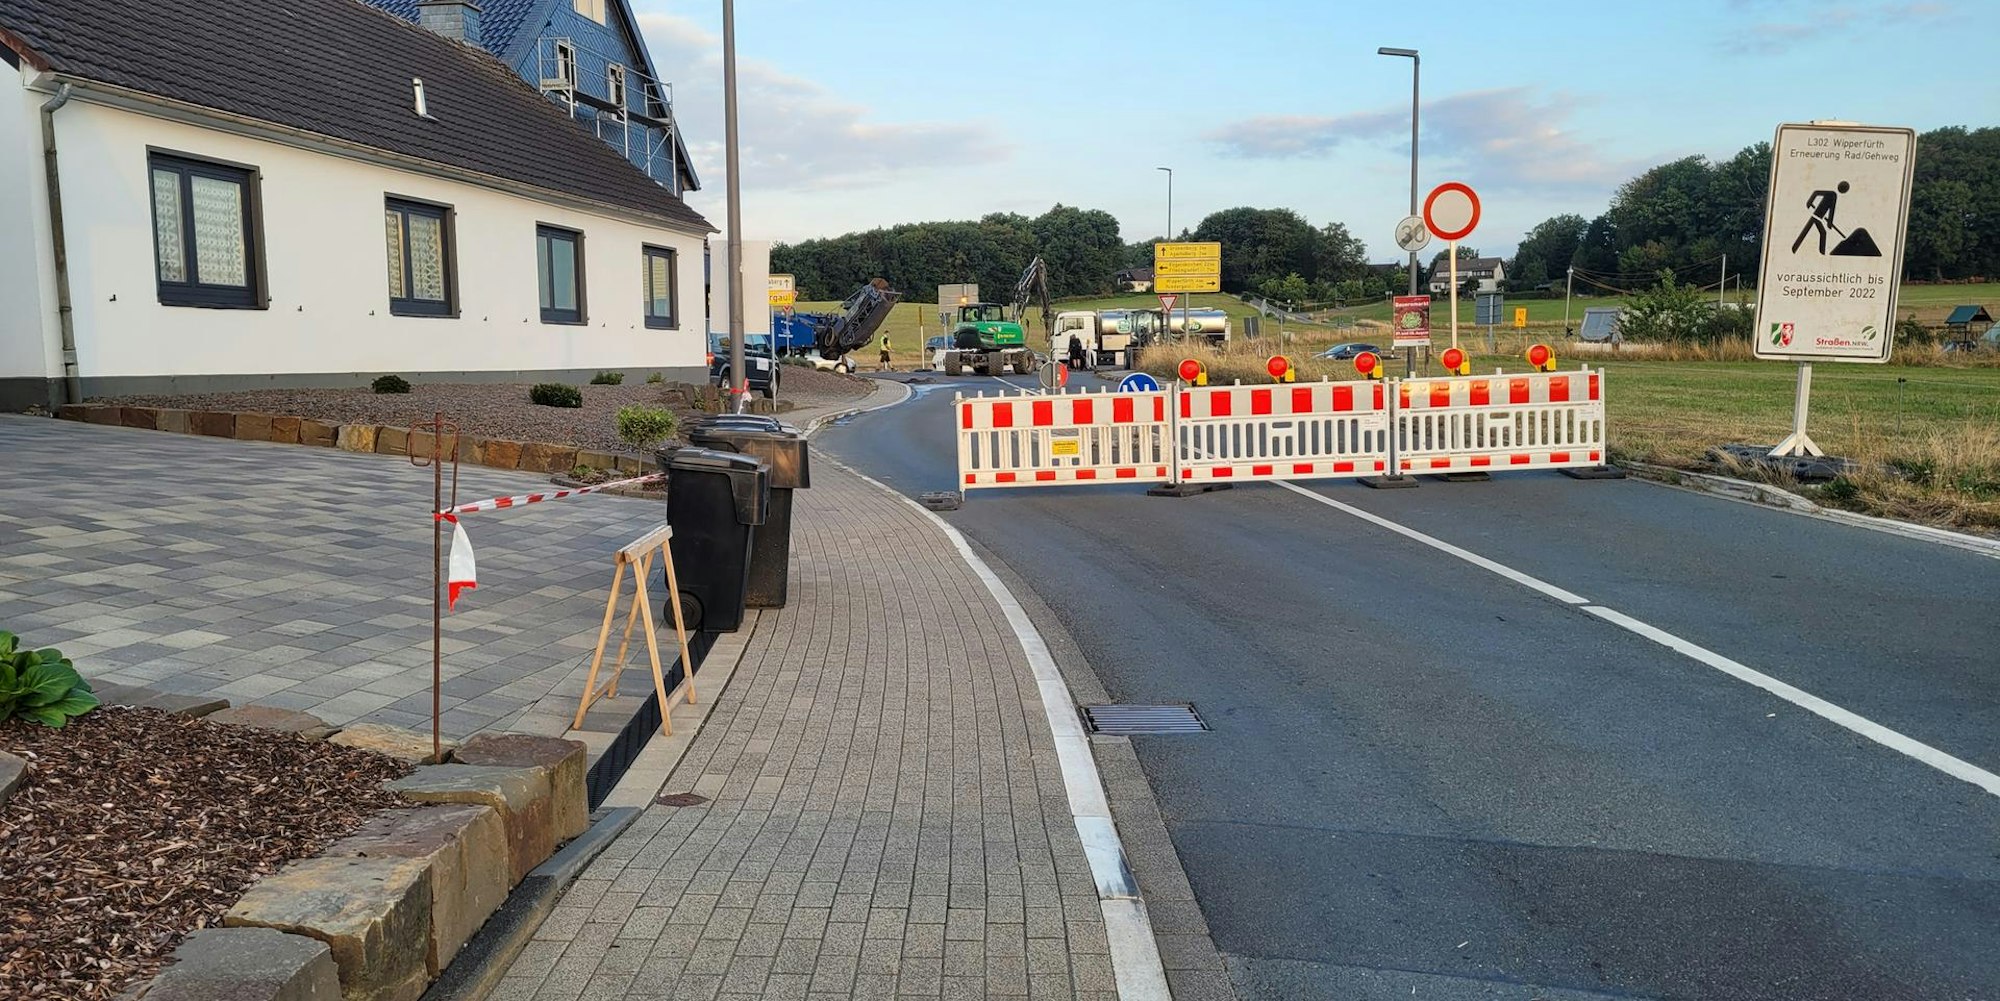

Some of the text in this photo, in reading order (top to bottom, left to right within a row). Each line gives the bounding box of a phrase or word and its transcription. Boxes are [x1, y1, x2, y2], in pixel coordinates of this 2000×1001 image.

[1807, 138, 1884, 149] L302 Wipperfürth
[1790, 149, 1899, 162] Erneuerung Rad/Gehweg
[1777, 273, 1884, 285] voraussichtlich bis
[768, 294, 791, 302] rgaul
[1783, 286, 1876, 299] September 2022
